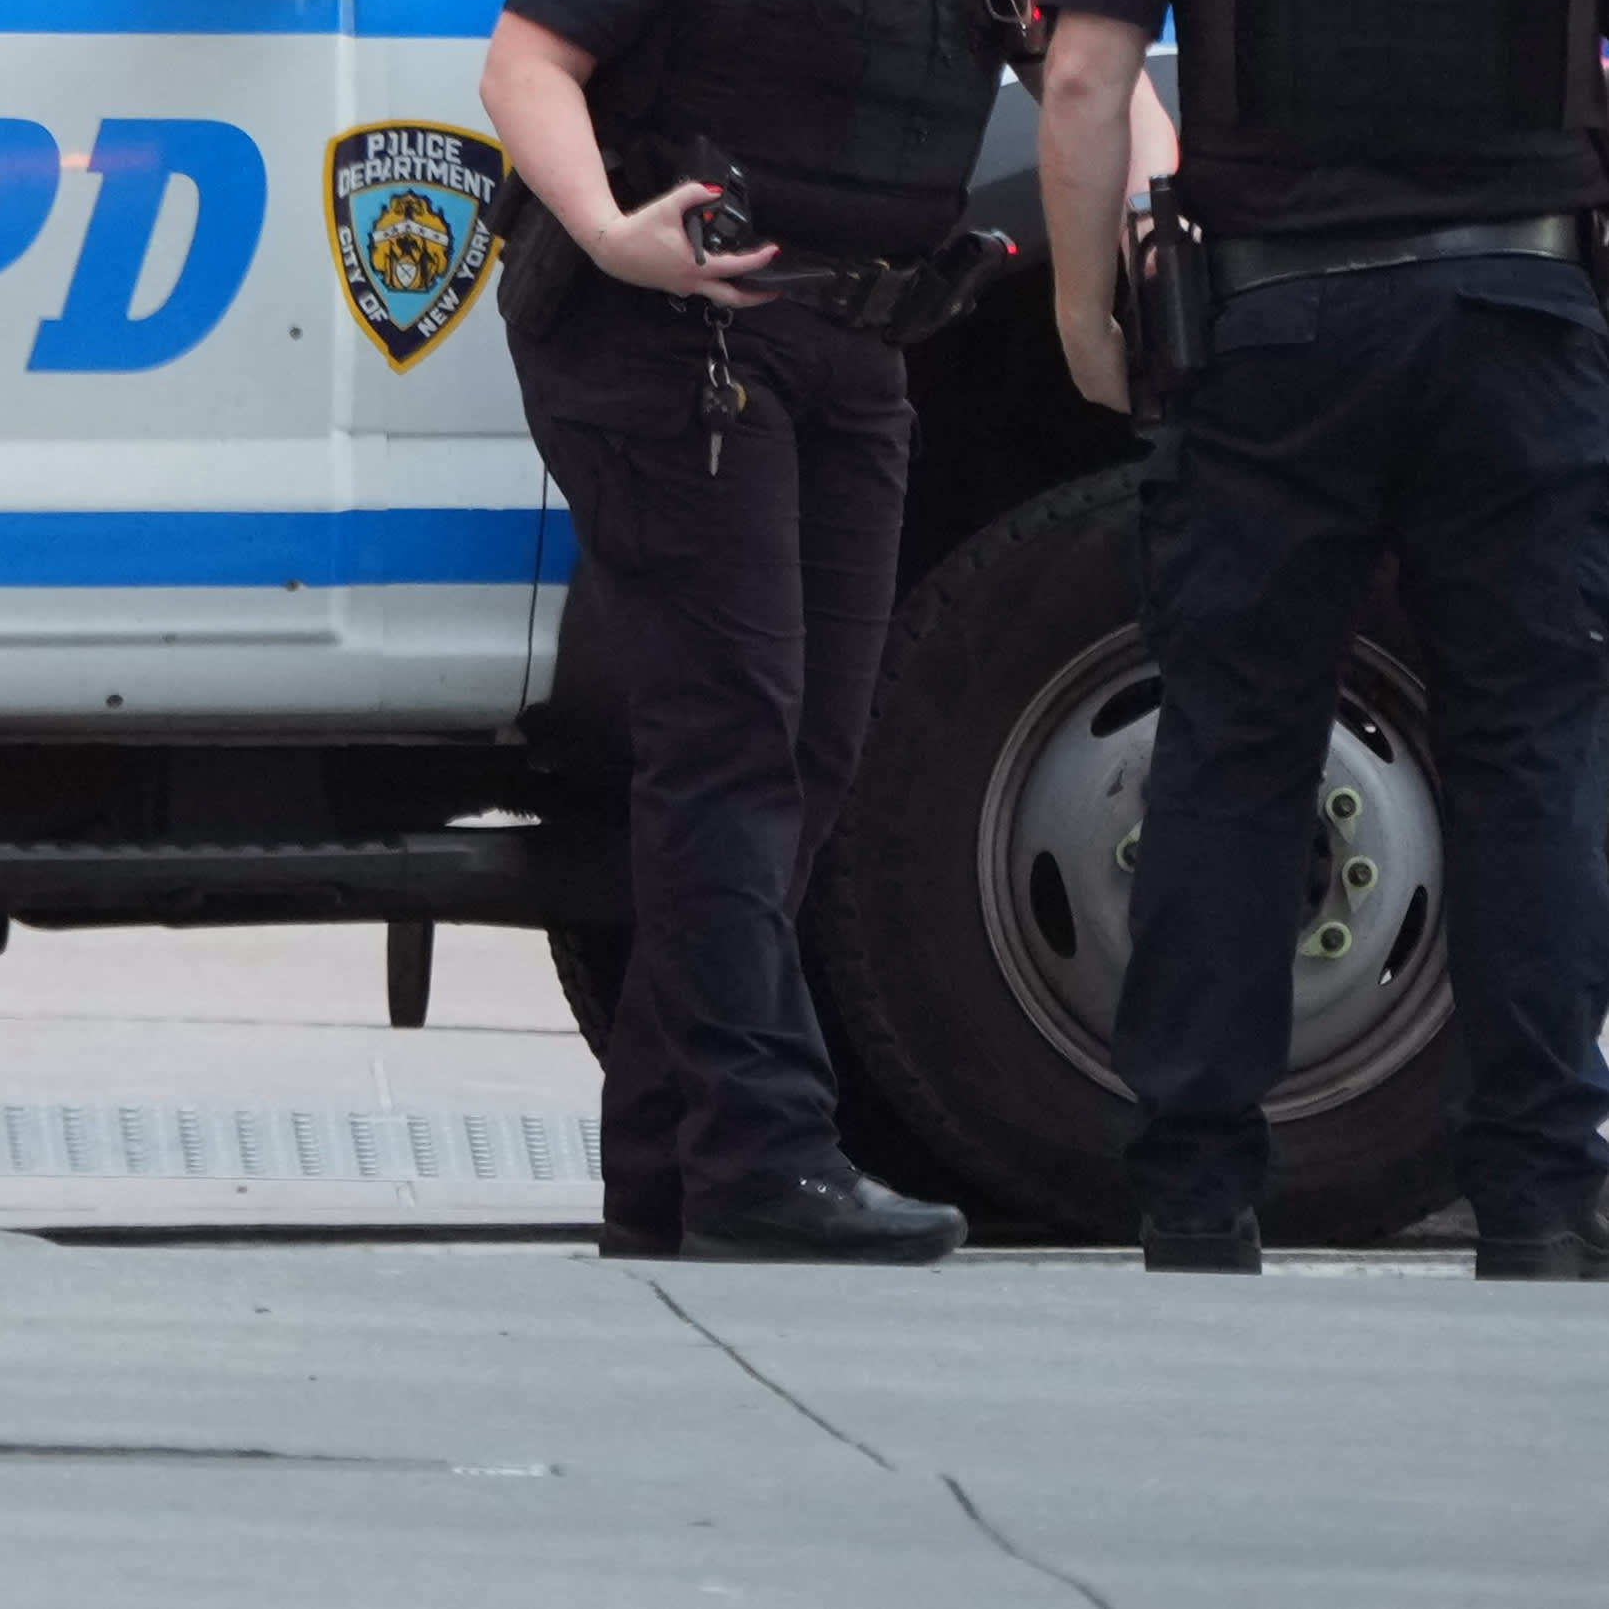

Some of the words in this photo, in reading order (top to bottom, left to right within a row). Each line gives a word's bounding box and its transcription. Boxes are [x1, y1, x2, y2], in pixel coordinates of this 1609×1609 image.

[367, 129, 464, 165] POLICE
[338, 155, 496, 203] DEPARTMENT
[338, 224, 366, 283] CITY
[358, 293, 389, 323] OF
[416, 286, 460, 338] NEW
